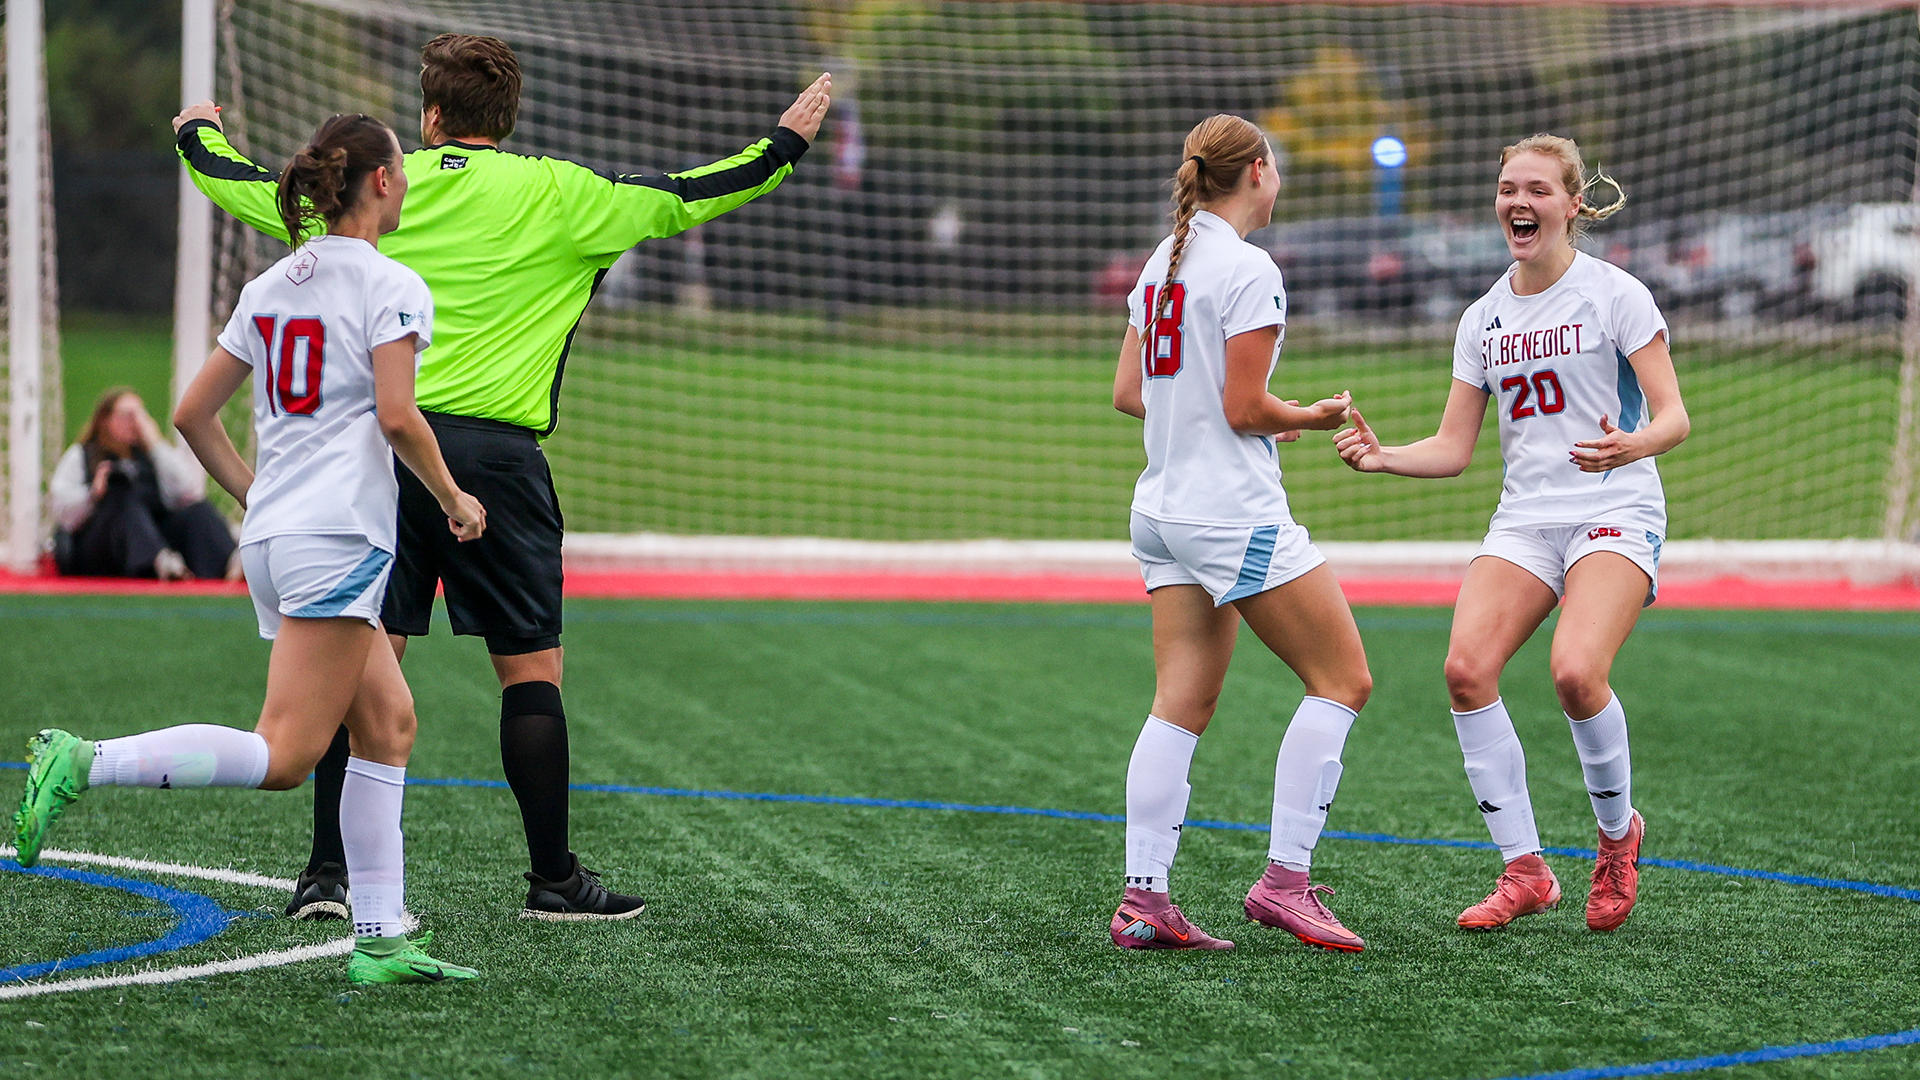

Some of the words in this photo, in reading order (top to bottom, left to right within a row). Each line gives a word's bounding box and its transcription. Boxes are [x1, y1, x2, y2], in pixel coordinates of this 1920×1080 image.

[251, 312, 327, 418] 10
[1143, 279, 1189, 380] 18
[1500, 368, 1567, 423] 20
